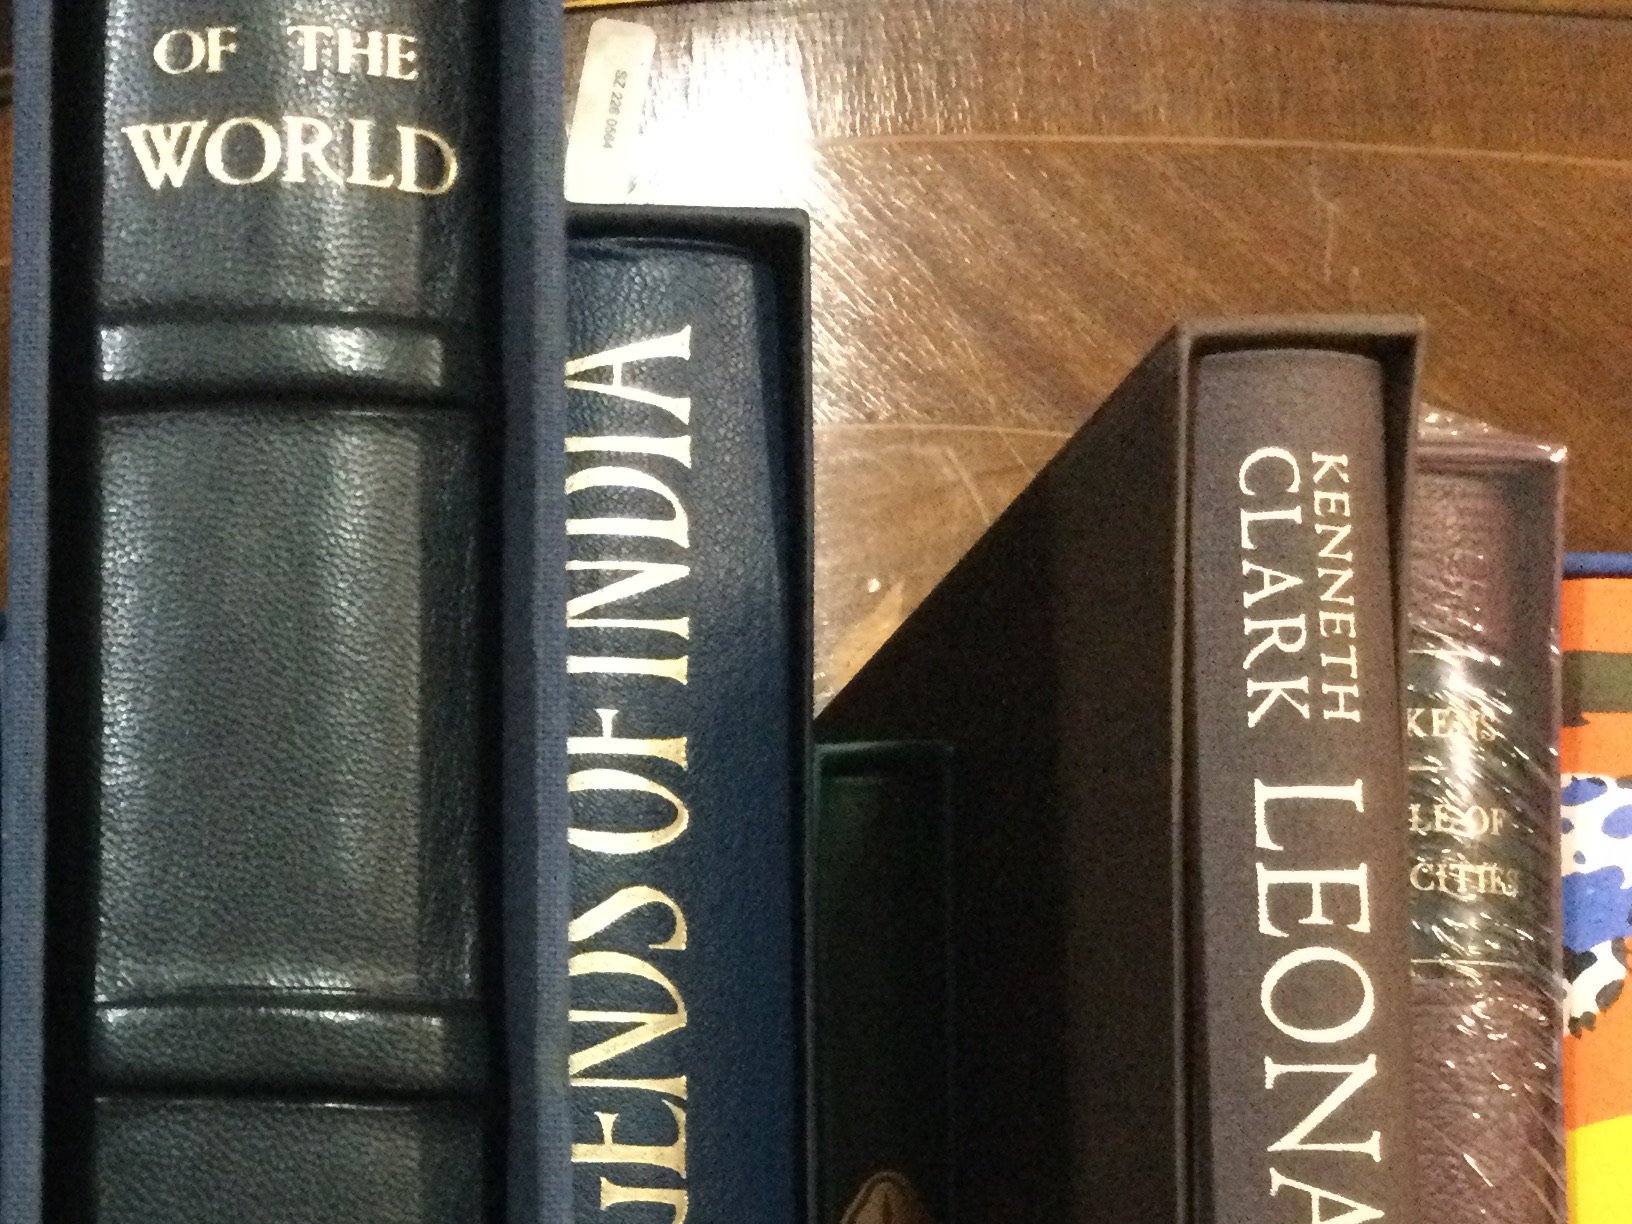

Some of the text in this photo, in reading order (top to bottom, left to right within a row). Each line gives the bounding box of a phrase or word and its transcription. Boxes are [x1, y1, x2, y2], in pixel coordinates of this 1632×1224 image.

[121, 115, 460, 196] WORLD
[152, 24, 419, 82] OF THE
[565, 325, 692, 685] INDIA
[1238, 446, 1311, 728] CLARK
[1311, 450, 1361, 723] KENNETH
